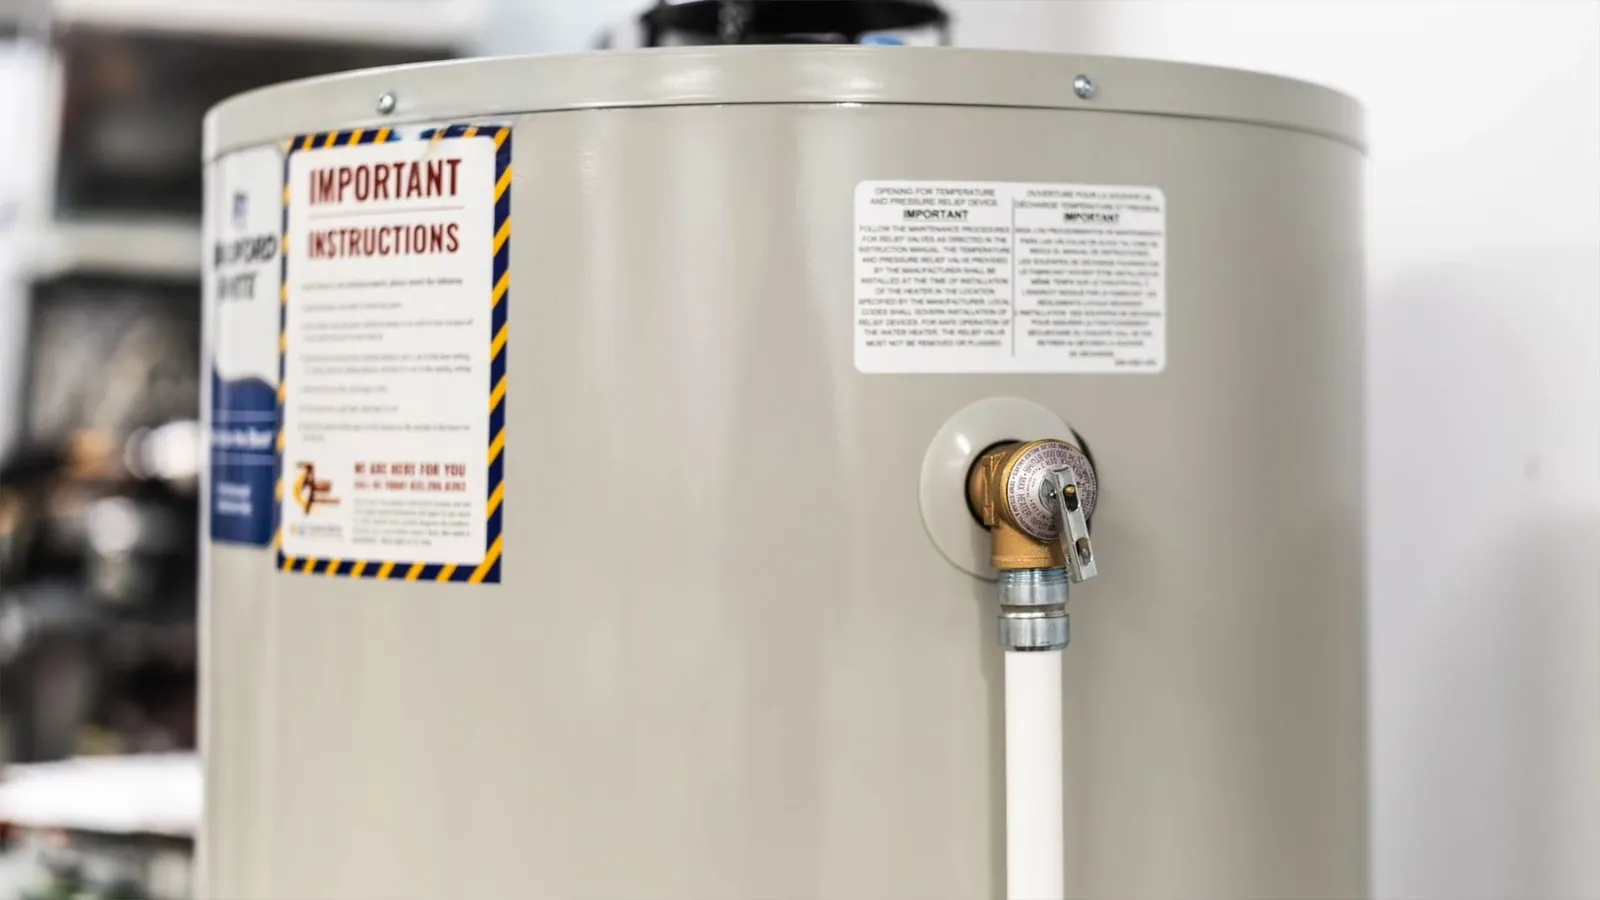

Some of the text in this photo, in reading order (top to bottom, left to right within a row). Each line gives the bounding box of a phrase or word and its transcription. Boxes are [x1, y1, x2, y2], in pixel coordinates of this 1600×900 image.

[310, 158, 462, 206] IMPORTANT
[874, 188, 995, 196] OPENING FOR TEMPERATURE
[870, 198, 888, 206] AND
[890, 198, 936, 206] PRESSURE
[903, 210, 968, 219] IMPORTANT
[1064, 212, 1120, 222] IMPORTANT
[307, 223, 460, 260] INSTRUCTIONS
[370, 464, 387, 474] ARE
[391, 464, 416, 476] HERE
[420, 464, 440, 476] FOR
[444, 464, 466, 477] YOU
[1018, 475, 1027, 491] MAX
[1017, 495, 1031, 517] HEATER
